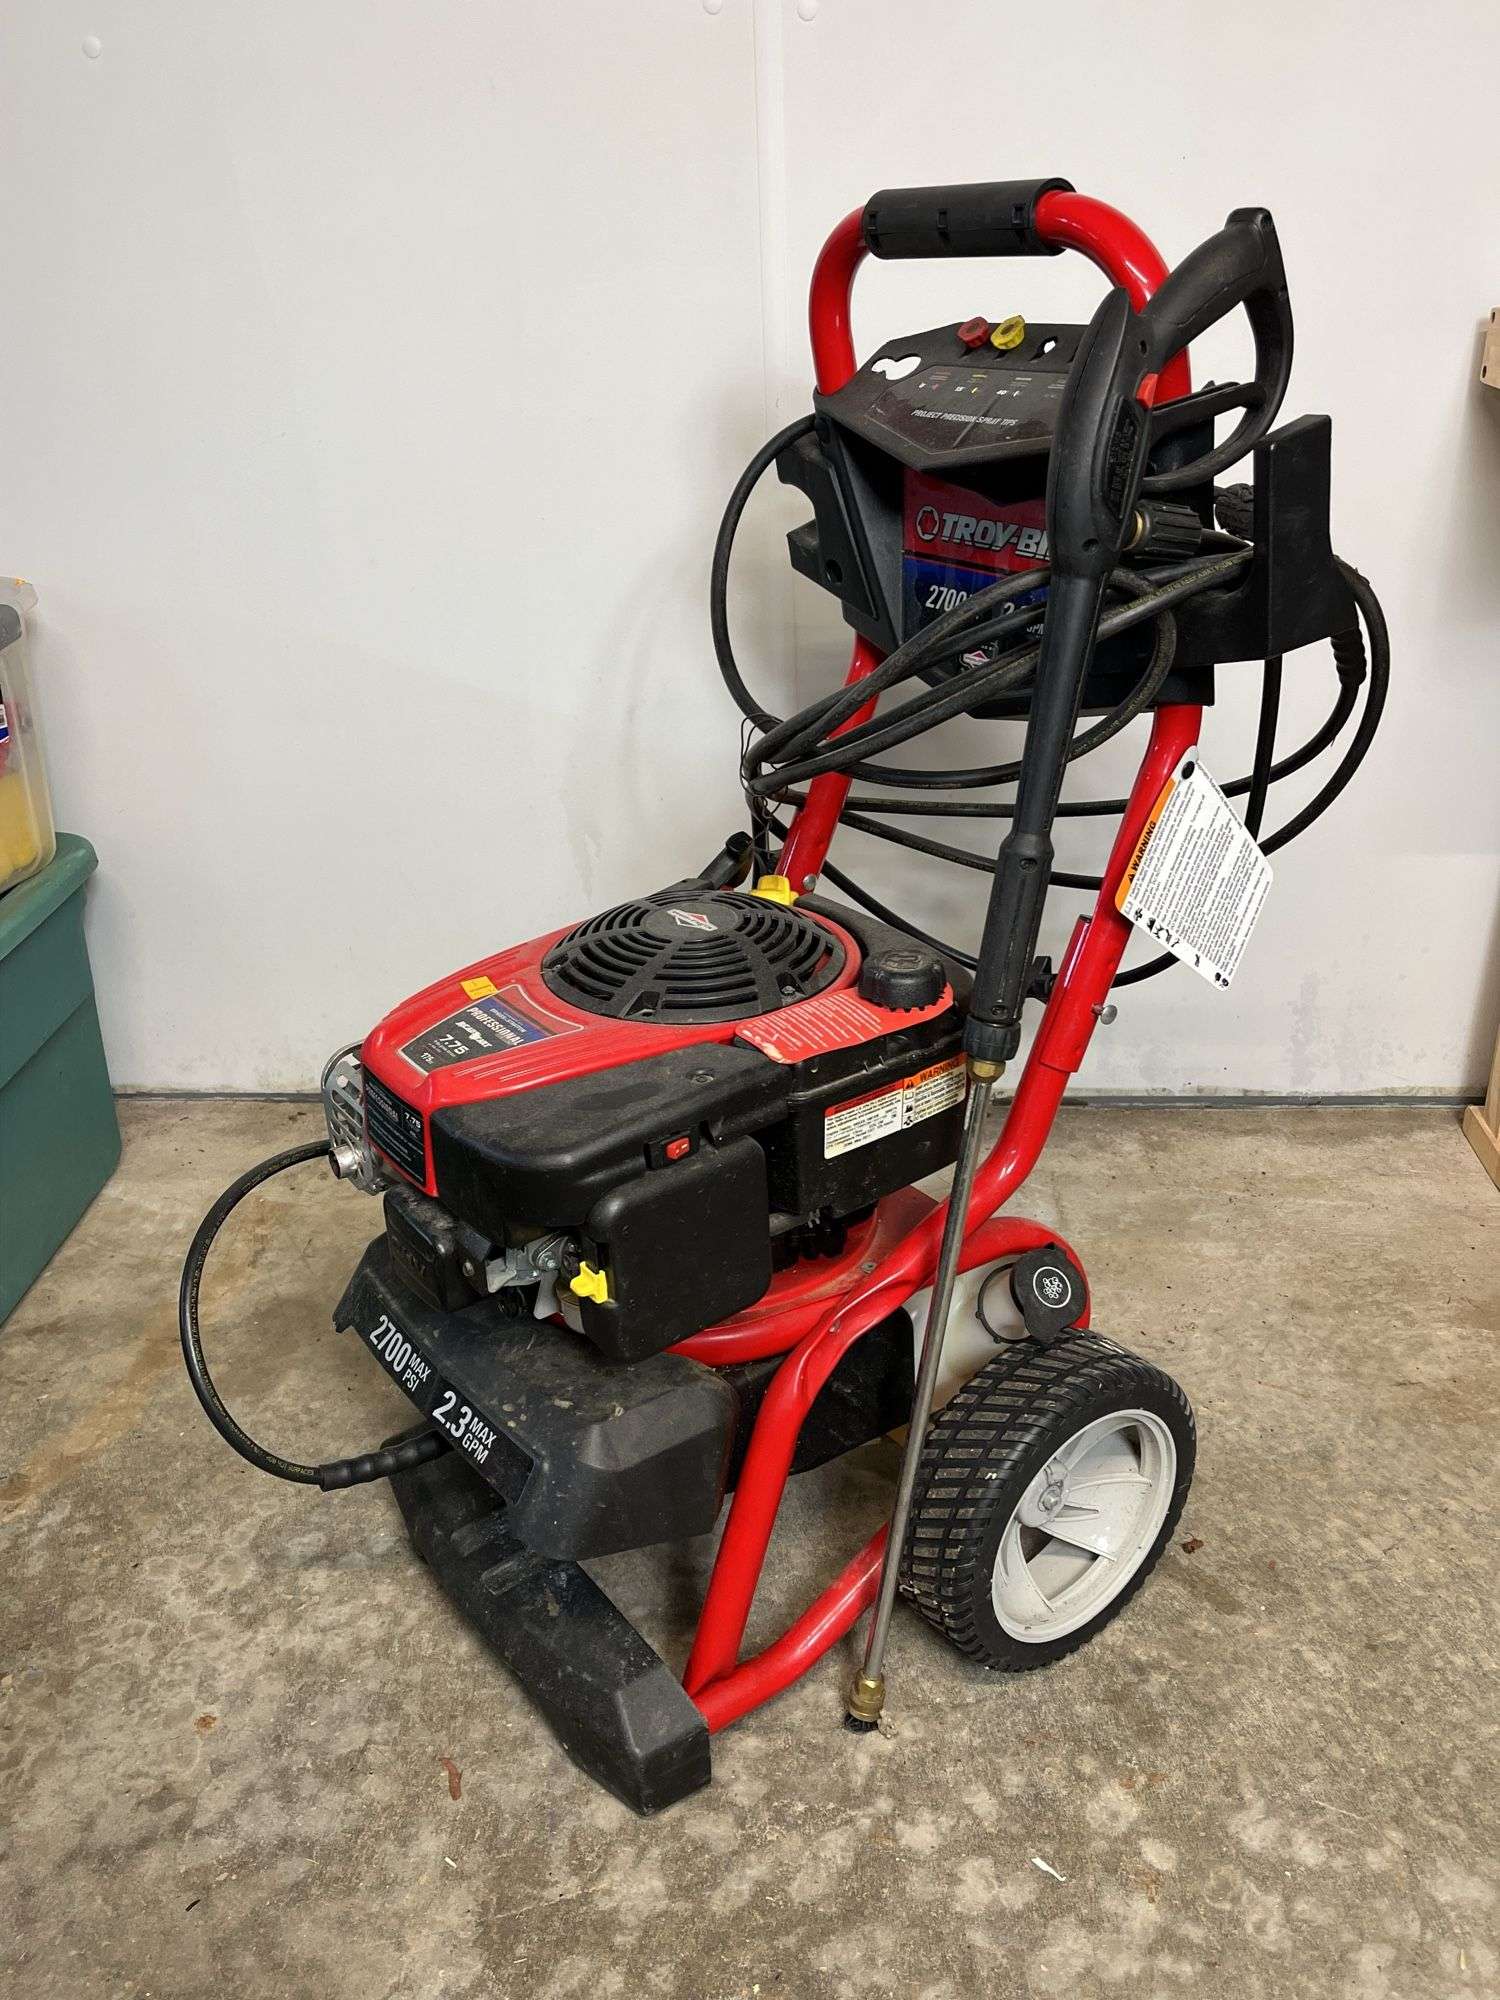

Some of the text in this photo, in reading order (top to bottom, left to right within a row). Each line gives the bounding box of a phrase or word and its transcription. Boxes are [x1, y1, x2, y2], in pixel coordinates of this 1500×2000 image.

[910, 409, 1019, 426] PROJECT PRECISION SPRAY TIPS
[941, 512, 1050, 560] TROY-BI
[1130, 820, 1157, 872] WARNING
[439, 1033, 470, 1055] 7.75
[466, 1006, 524, 1046] PROFESSIONAL
[404, 1111, 421, 1129] 7.75
[369, 1314, 432, 1383] 2700 MAX
[402, 1368, 420, 1392] PSI
[432, 1390, 498, 1449] 2.3 MAX
[461, 1432, 490, 1465] GPM
